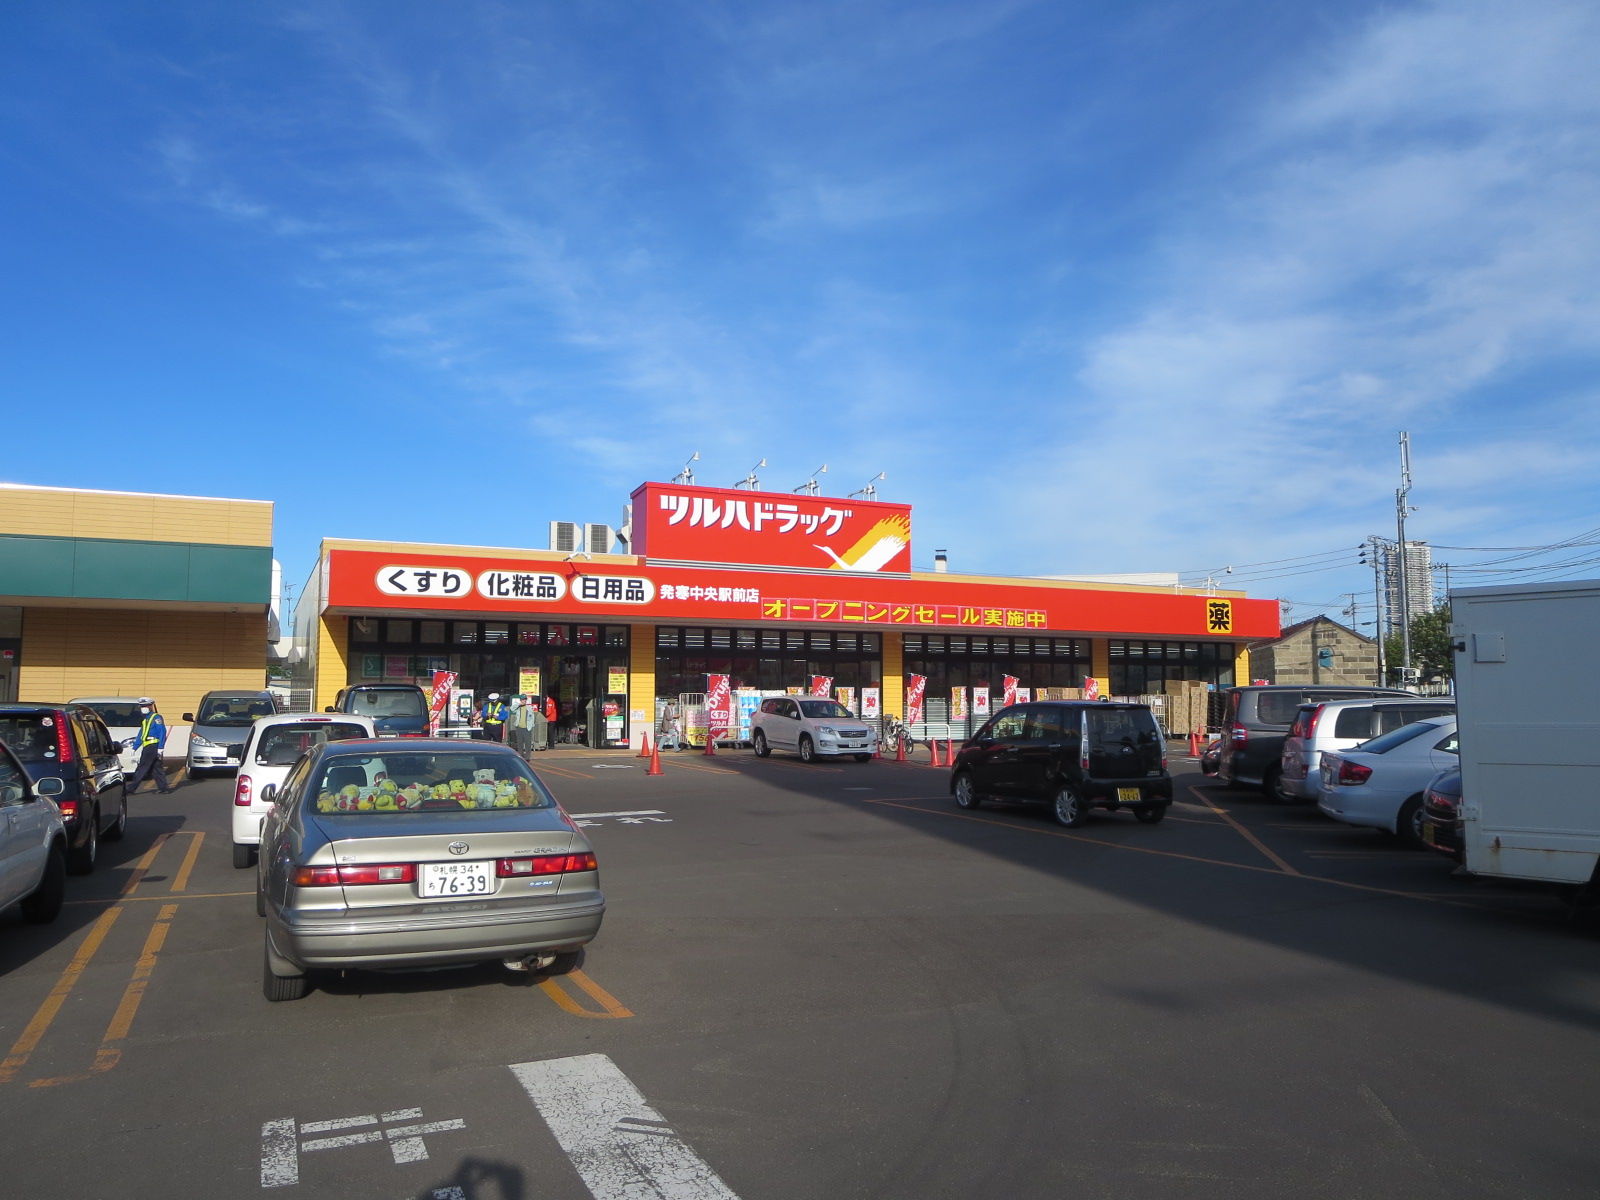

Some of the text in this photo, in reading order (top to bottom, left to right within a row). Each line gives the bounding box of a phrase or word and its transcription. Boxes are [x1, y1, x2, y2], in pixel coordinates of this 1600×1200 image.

[660, 495, 853, 536] ツルハドラッグ
[388, 569, 461, 594] くすり
[487, 573, 557, 599] 化粧品
[582, 576, 645, 602] 日用品
[660, 584, 760, 603] 発寒中央駅前店
[763, 599, 1047, 628] オープニングセール実施中
[1209, 602, 1230, 630] 薬
[438, 874, 486, 894] 76-39
